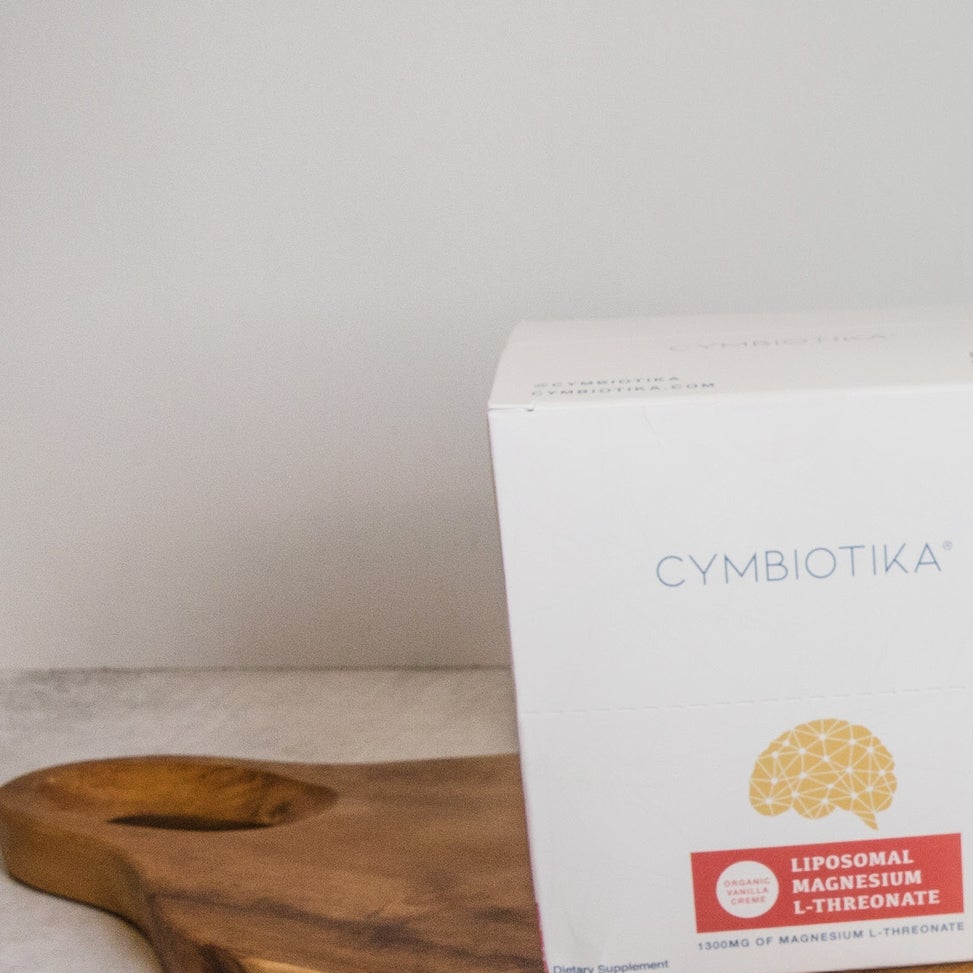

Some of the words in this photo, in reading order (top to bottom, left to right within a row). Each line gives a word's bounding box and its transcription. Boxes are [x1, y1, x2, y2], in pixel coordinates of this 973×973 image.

[791, 849, 914, 873] LIPOSOMAL
[723, 876, 771, 888] ORGANIC
[726, 886, 769, 897] VANILLA
[792, 870, 922, 894] MAGNESIUM
[730, 895, 767, 905] CREME
[793, 889, 941, 915] L-THREONATE
[698, 938, 751, 951] 1300MG
[755, 936, 773, 946] OF
[779, 930, 863, 945] MAGNESIUM
[869, 921, 965, 938] L-THREONATE
[597, 959, 669, 973] Supplement
